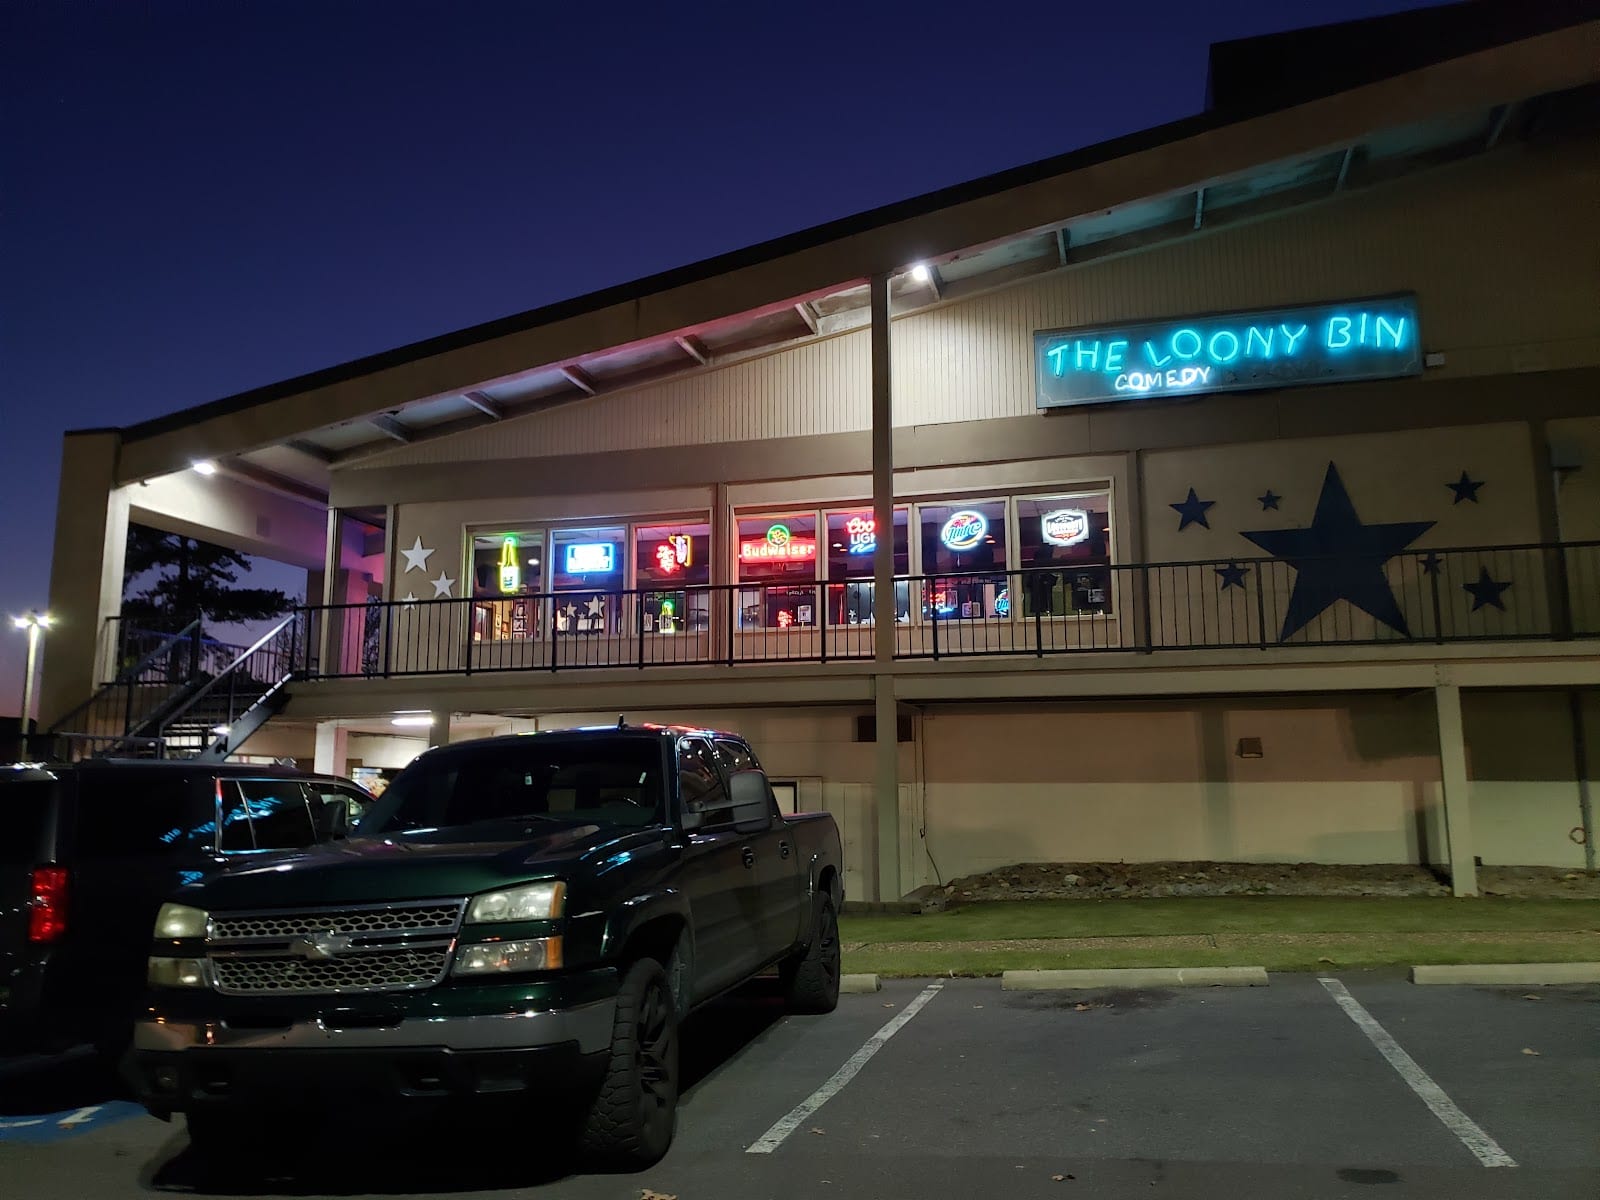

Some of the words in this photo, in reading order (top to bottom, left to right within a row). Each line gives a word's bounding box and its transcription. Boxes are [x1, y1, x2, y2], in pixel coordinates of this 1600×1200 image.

[1047, 340, 1128, 376] THE
[1145, 323, 1307, 363] LOONY
[1327, 312, 1405, 349] BIN
[1114, 366, 1211, 391] COMEDY
[846, 517, 876, 533] Coo
[850, 532, 876, 545] LIG
[742, 543, 816, 558] Budweiser
